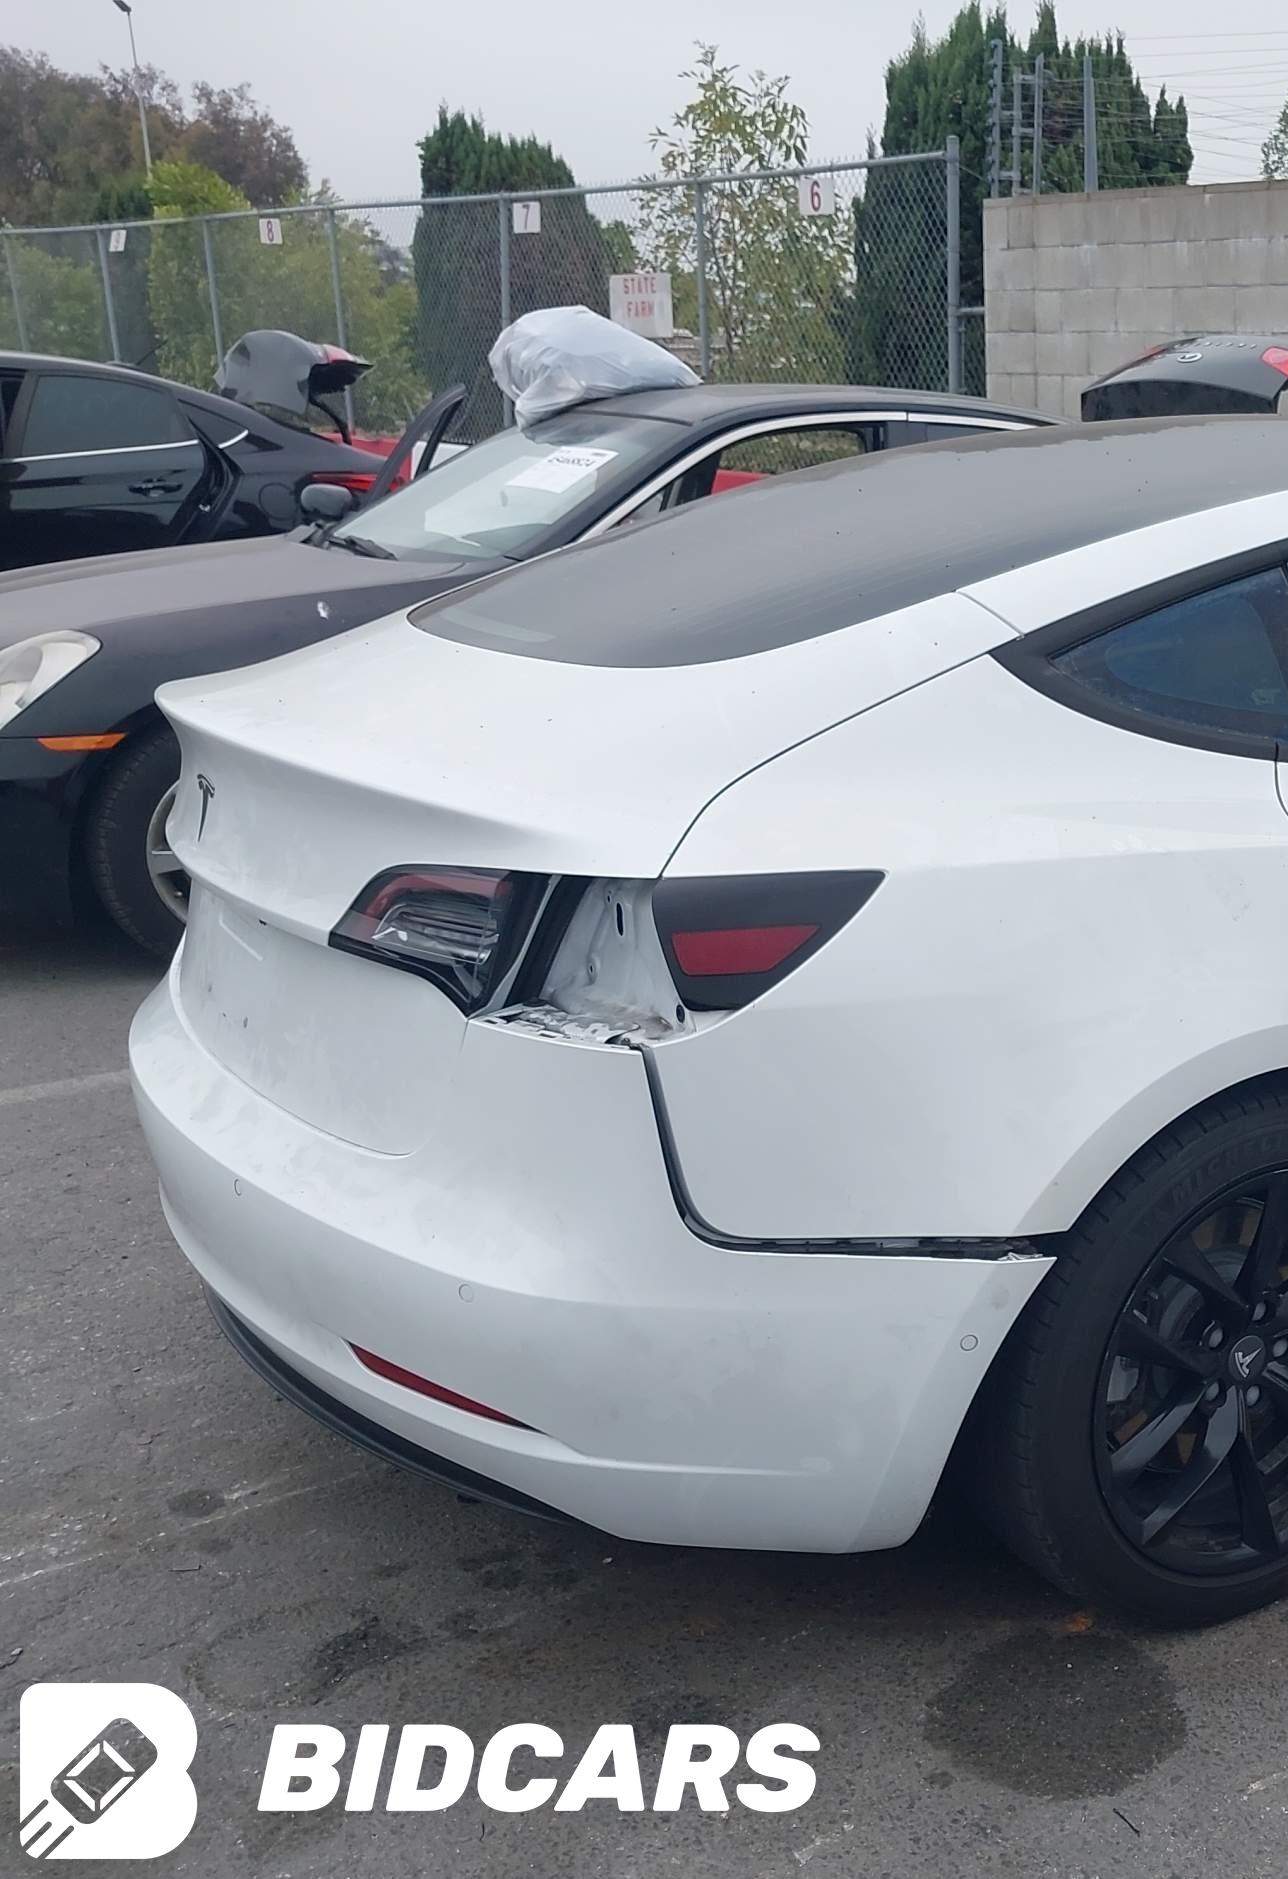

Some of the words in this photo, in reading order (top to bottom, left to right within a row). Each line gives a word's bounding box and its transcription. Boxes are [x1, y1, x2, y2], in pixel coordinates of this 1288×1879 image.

[810, 180, 822, 212] 6
[521, 203, 530, 231] 7
[266, 220, 275, 242] 8
[623, 276, 657, 295] STATE
